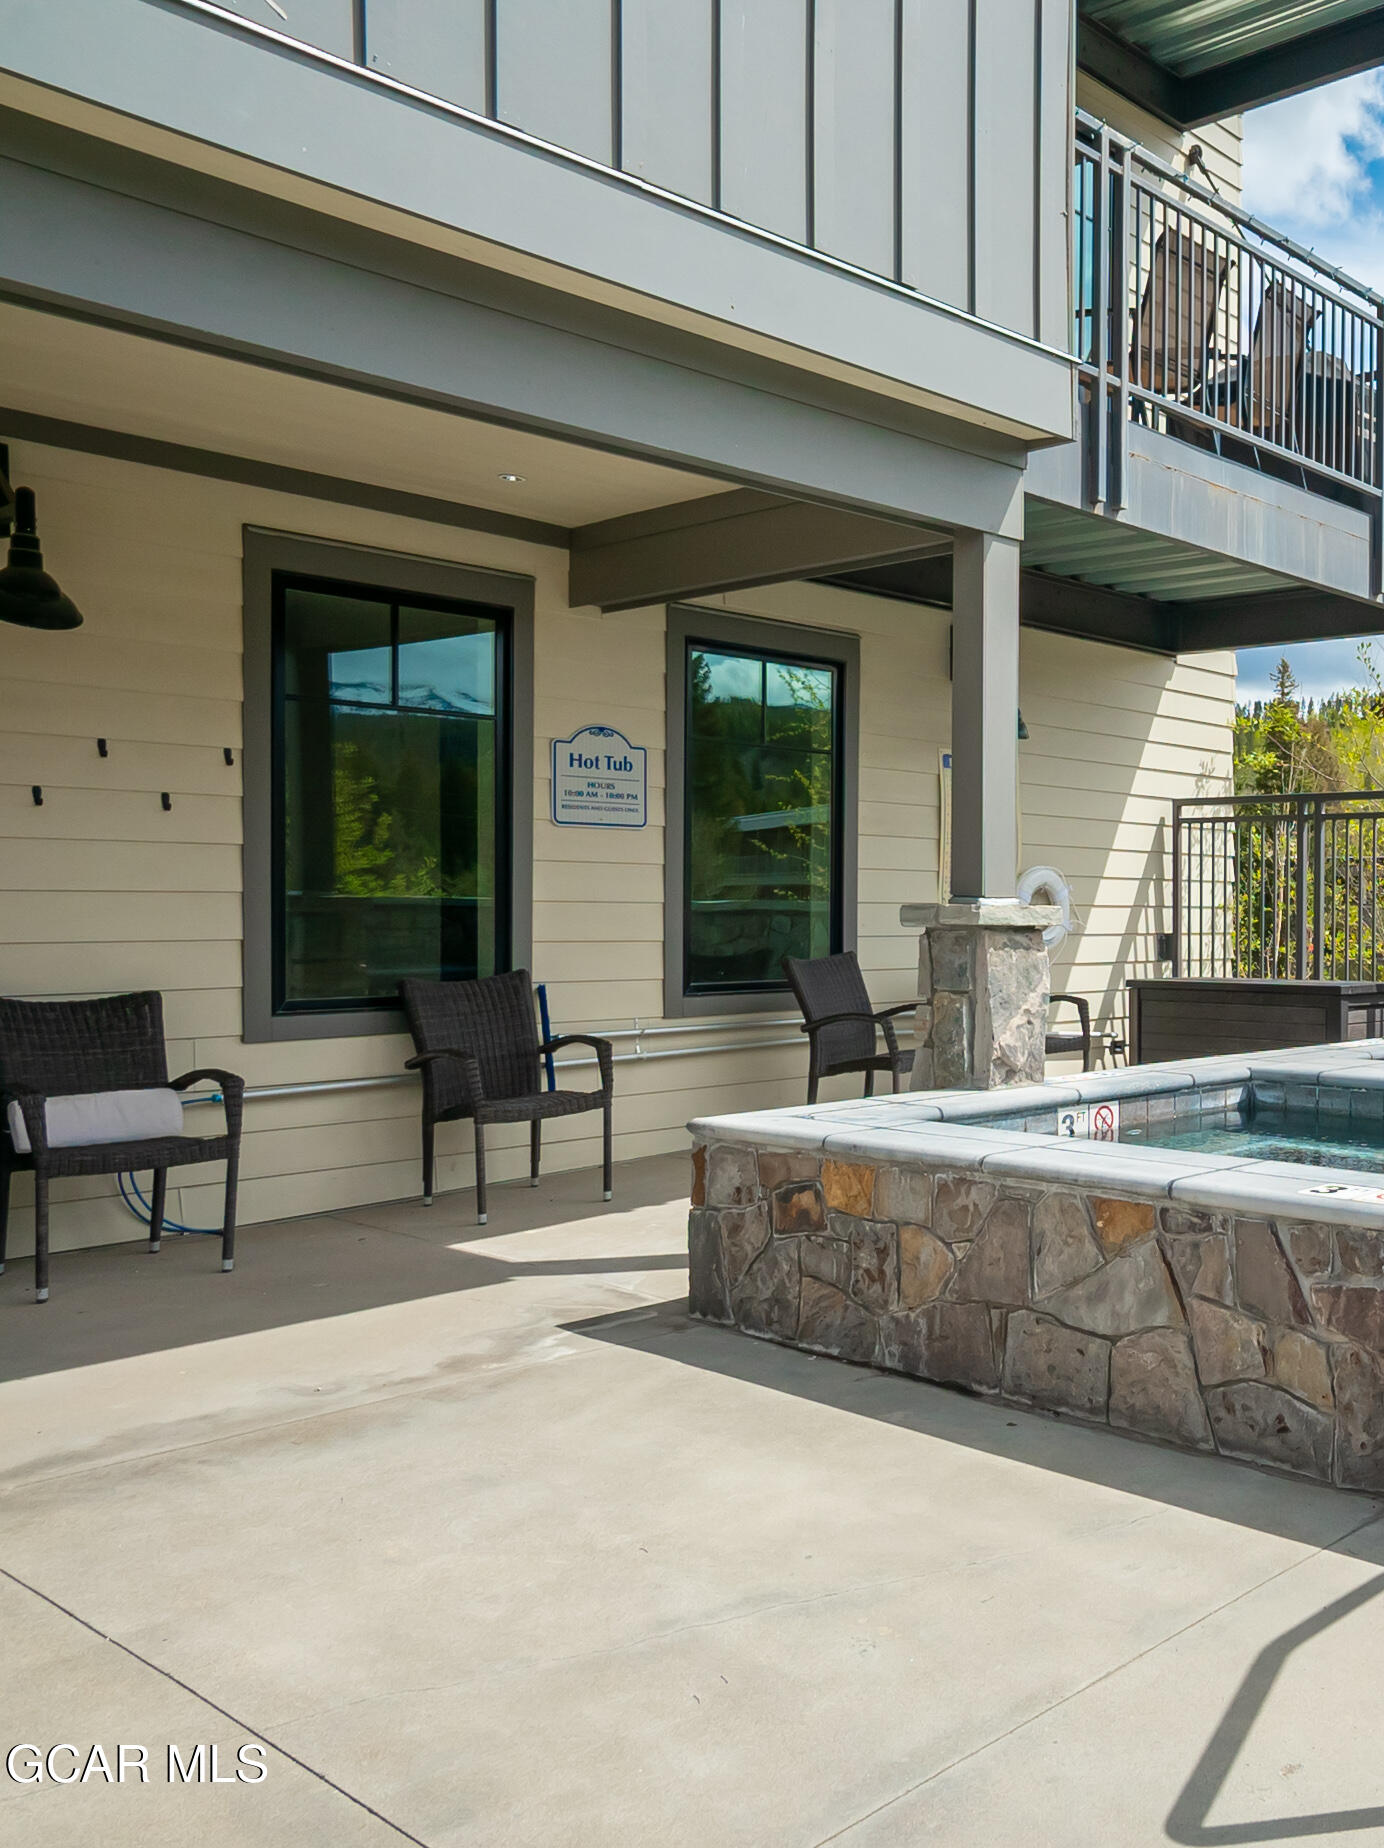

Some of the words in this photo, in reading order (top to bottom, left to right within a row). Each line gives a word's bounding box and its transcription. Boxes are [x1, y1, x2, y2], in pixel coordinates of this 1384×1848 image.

[569, 753, 600, 769] Hot
[604, 755, 633, 772] Tub
[587, 781, 615, 790] HOURS
[1062, 1114, 1075, 1137] 3
[1076, 1111, 1086, 1122] FT
[1310, 1185, 1348, 1194] 3
